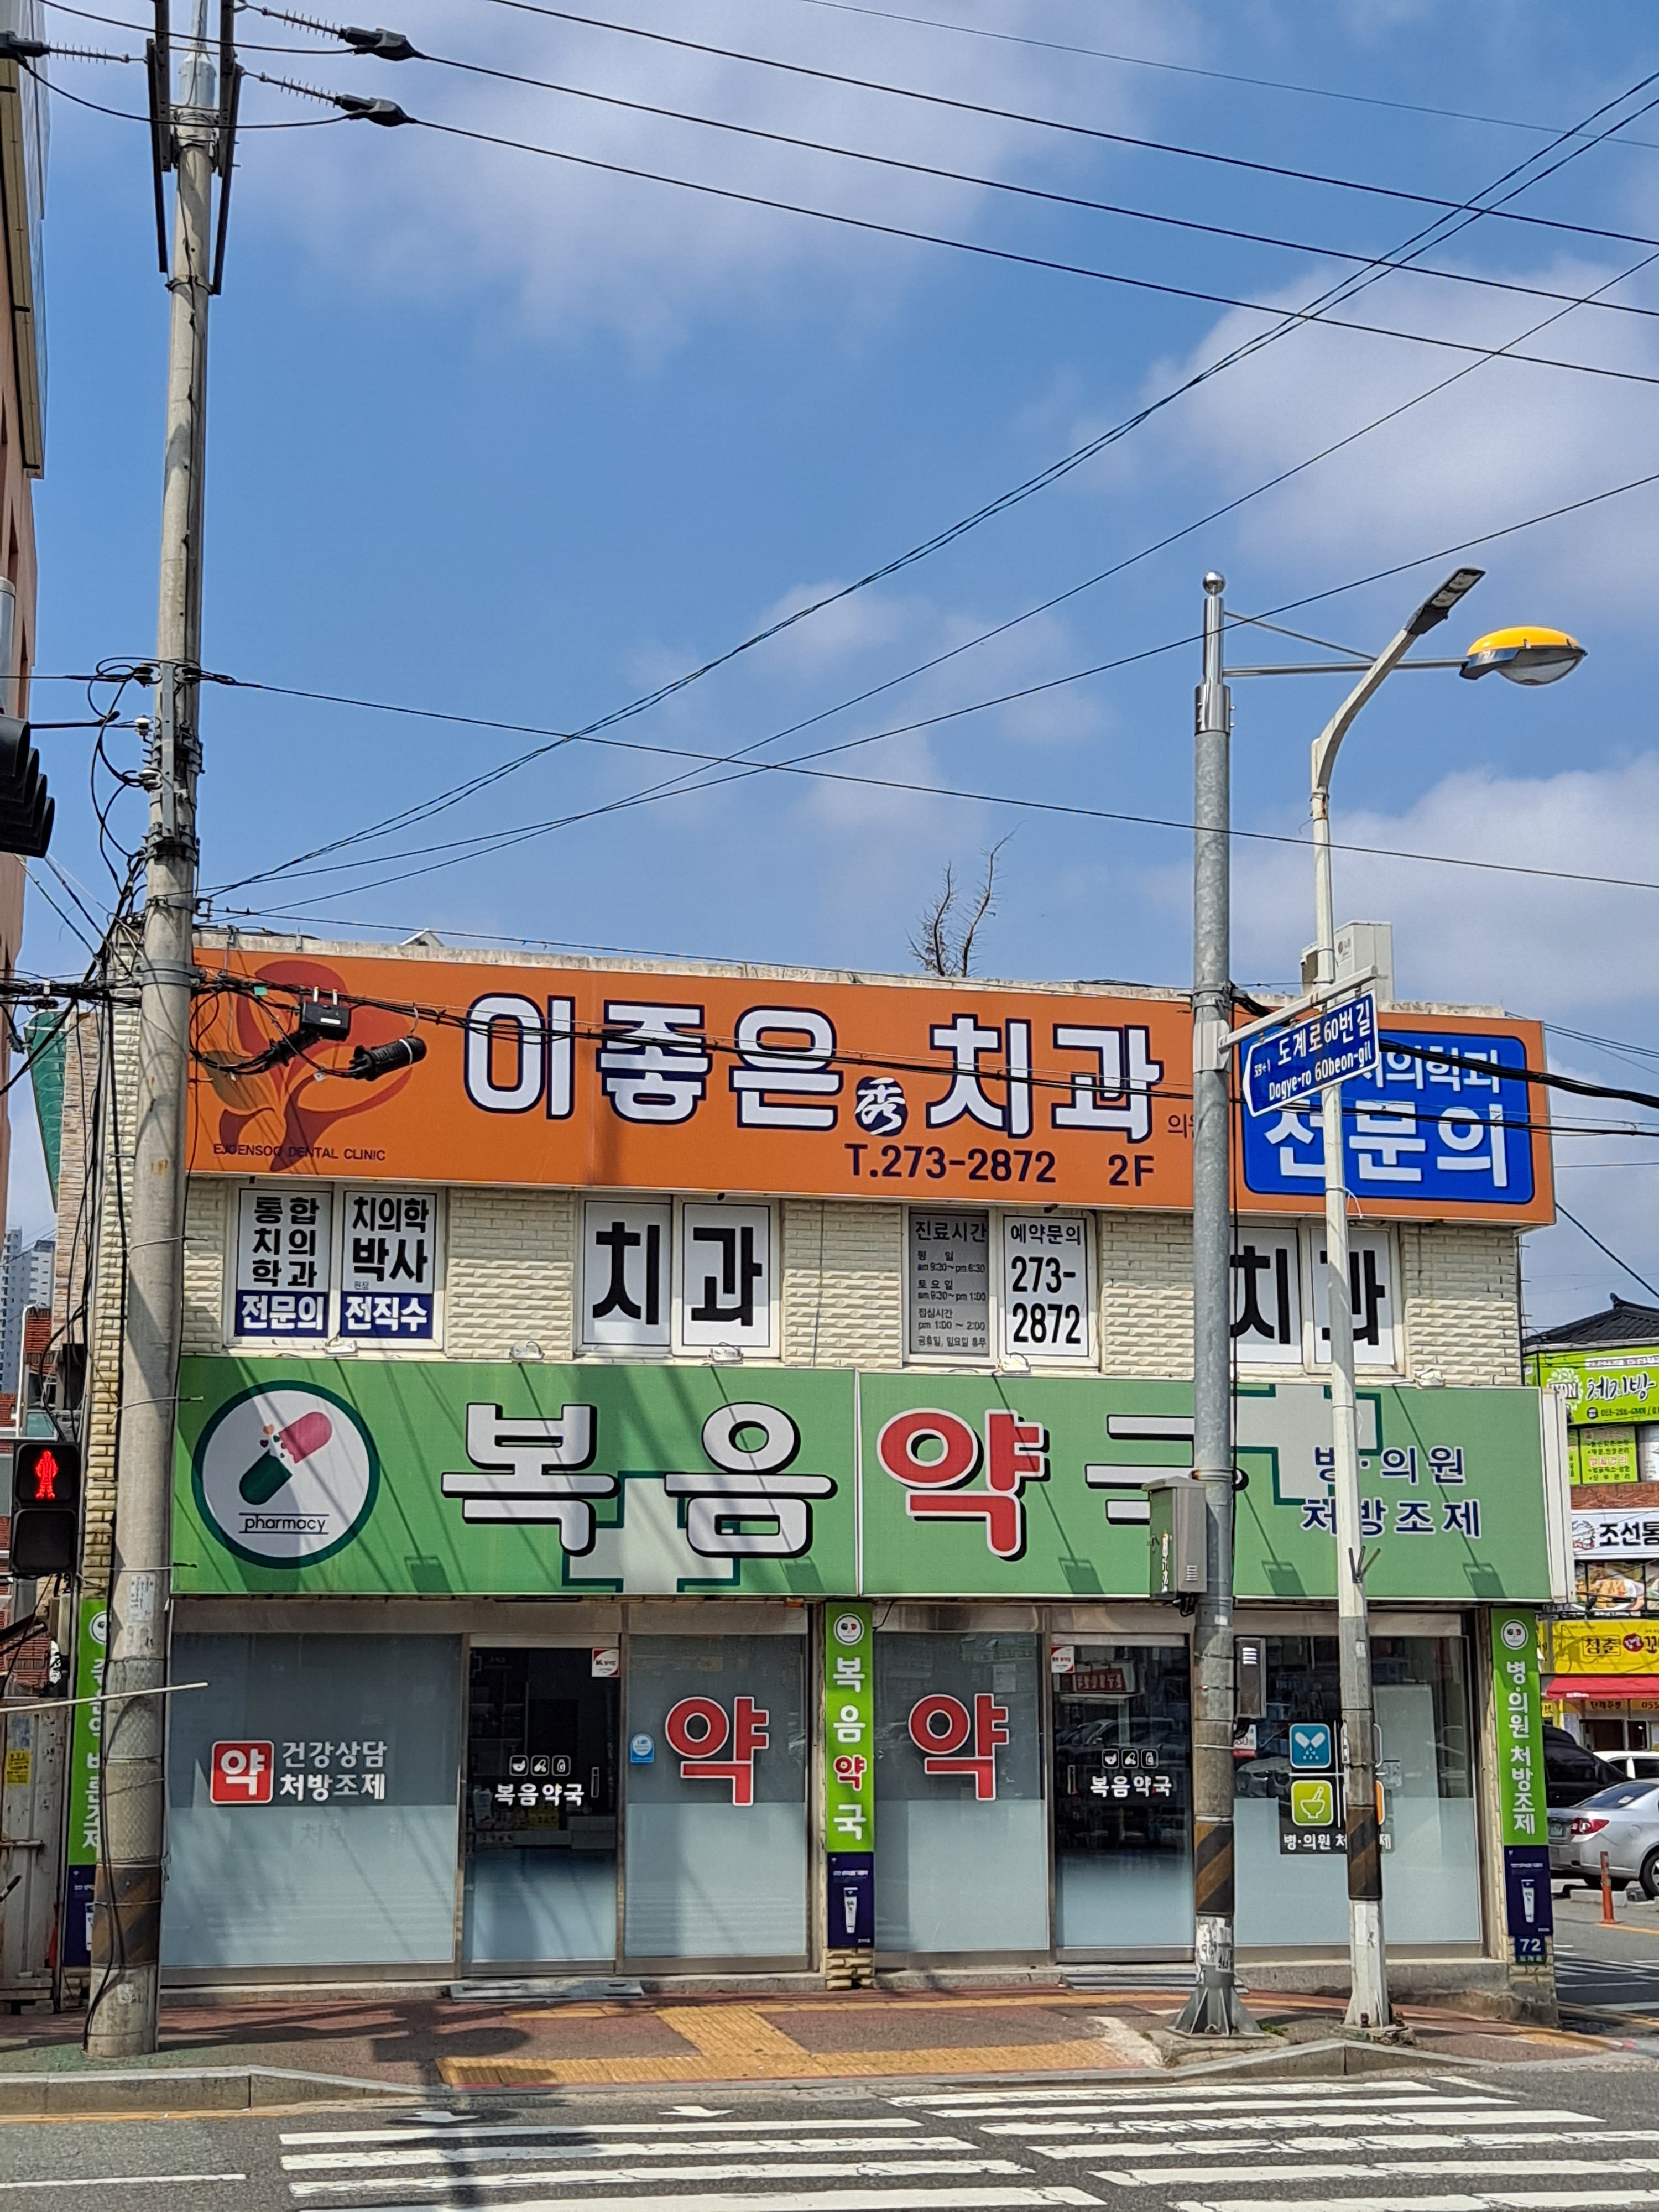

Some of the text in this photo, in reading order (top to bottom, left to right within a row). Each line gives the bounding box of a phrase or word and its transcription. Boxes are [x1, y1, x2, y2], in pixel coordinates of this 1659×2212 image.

[1278, 1000, 1371, 1066] 도계로60번길
[464, 992, 843, 1131] 이좋은
[926, 1014, 1164, 1143] 치과
[1269, 1040, 1371, 1101] Dogye-ro 60beon-gil
[1363, 1045, 1500, 1094] 의학과
[288, 1146, 338, 1159] DENTAL
[344, 1148, 386, 1161] CLINIC
[844, 1143, 1155, 1187] T.273-2872 2F
[254, 1196, 320, 1225] 통합
[353, 1196, 430, 1233] 치의학
[252, 1228, 317, 1256] 치의
[915, 1220, 987, 1243] 진료시간
[1011, 1223, 1081, 1245] 예약문의
[252, 1259, 318, 1288] 학과
[353, 1238, 429, 1283] 박사
[593, 1222, 763, 1327] 치과
[1011, 1255, 1076, 1293] 273-
[242, 1295, 324, 1331] 전문의
[345, 1297, 428, 1331] 전직수
[1013, 1302, 1081, 1344] 2872
[244, 1515, 327, 1533] pharmacy
[1301, 1496, 1482, 1539] 처방조제
[1506, 1661, 1530, 1738] 병·의원
[282, 1741, 388, 1768] 건강상담
[665, 1696, 769, 1807] 약
[908, 1693, 1009, 1801] 약
[221, 1748, 265, 1796] 약
[279, 1773, 385, 1801] 처방조제
[1090, 1776, 1172, 1798] 복음약국
[1510, 1745, 1536, 1835] 처방조제
[495, 1782, 585, 1807] 복음약국
[1283, 1833, 1331, 1850] 병·의원
[1520, 1938, 1541, 1952] 72
